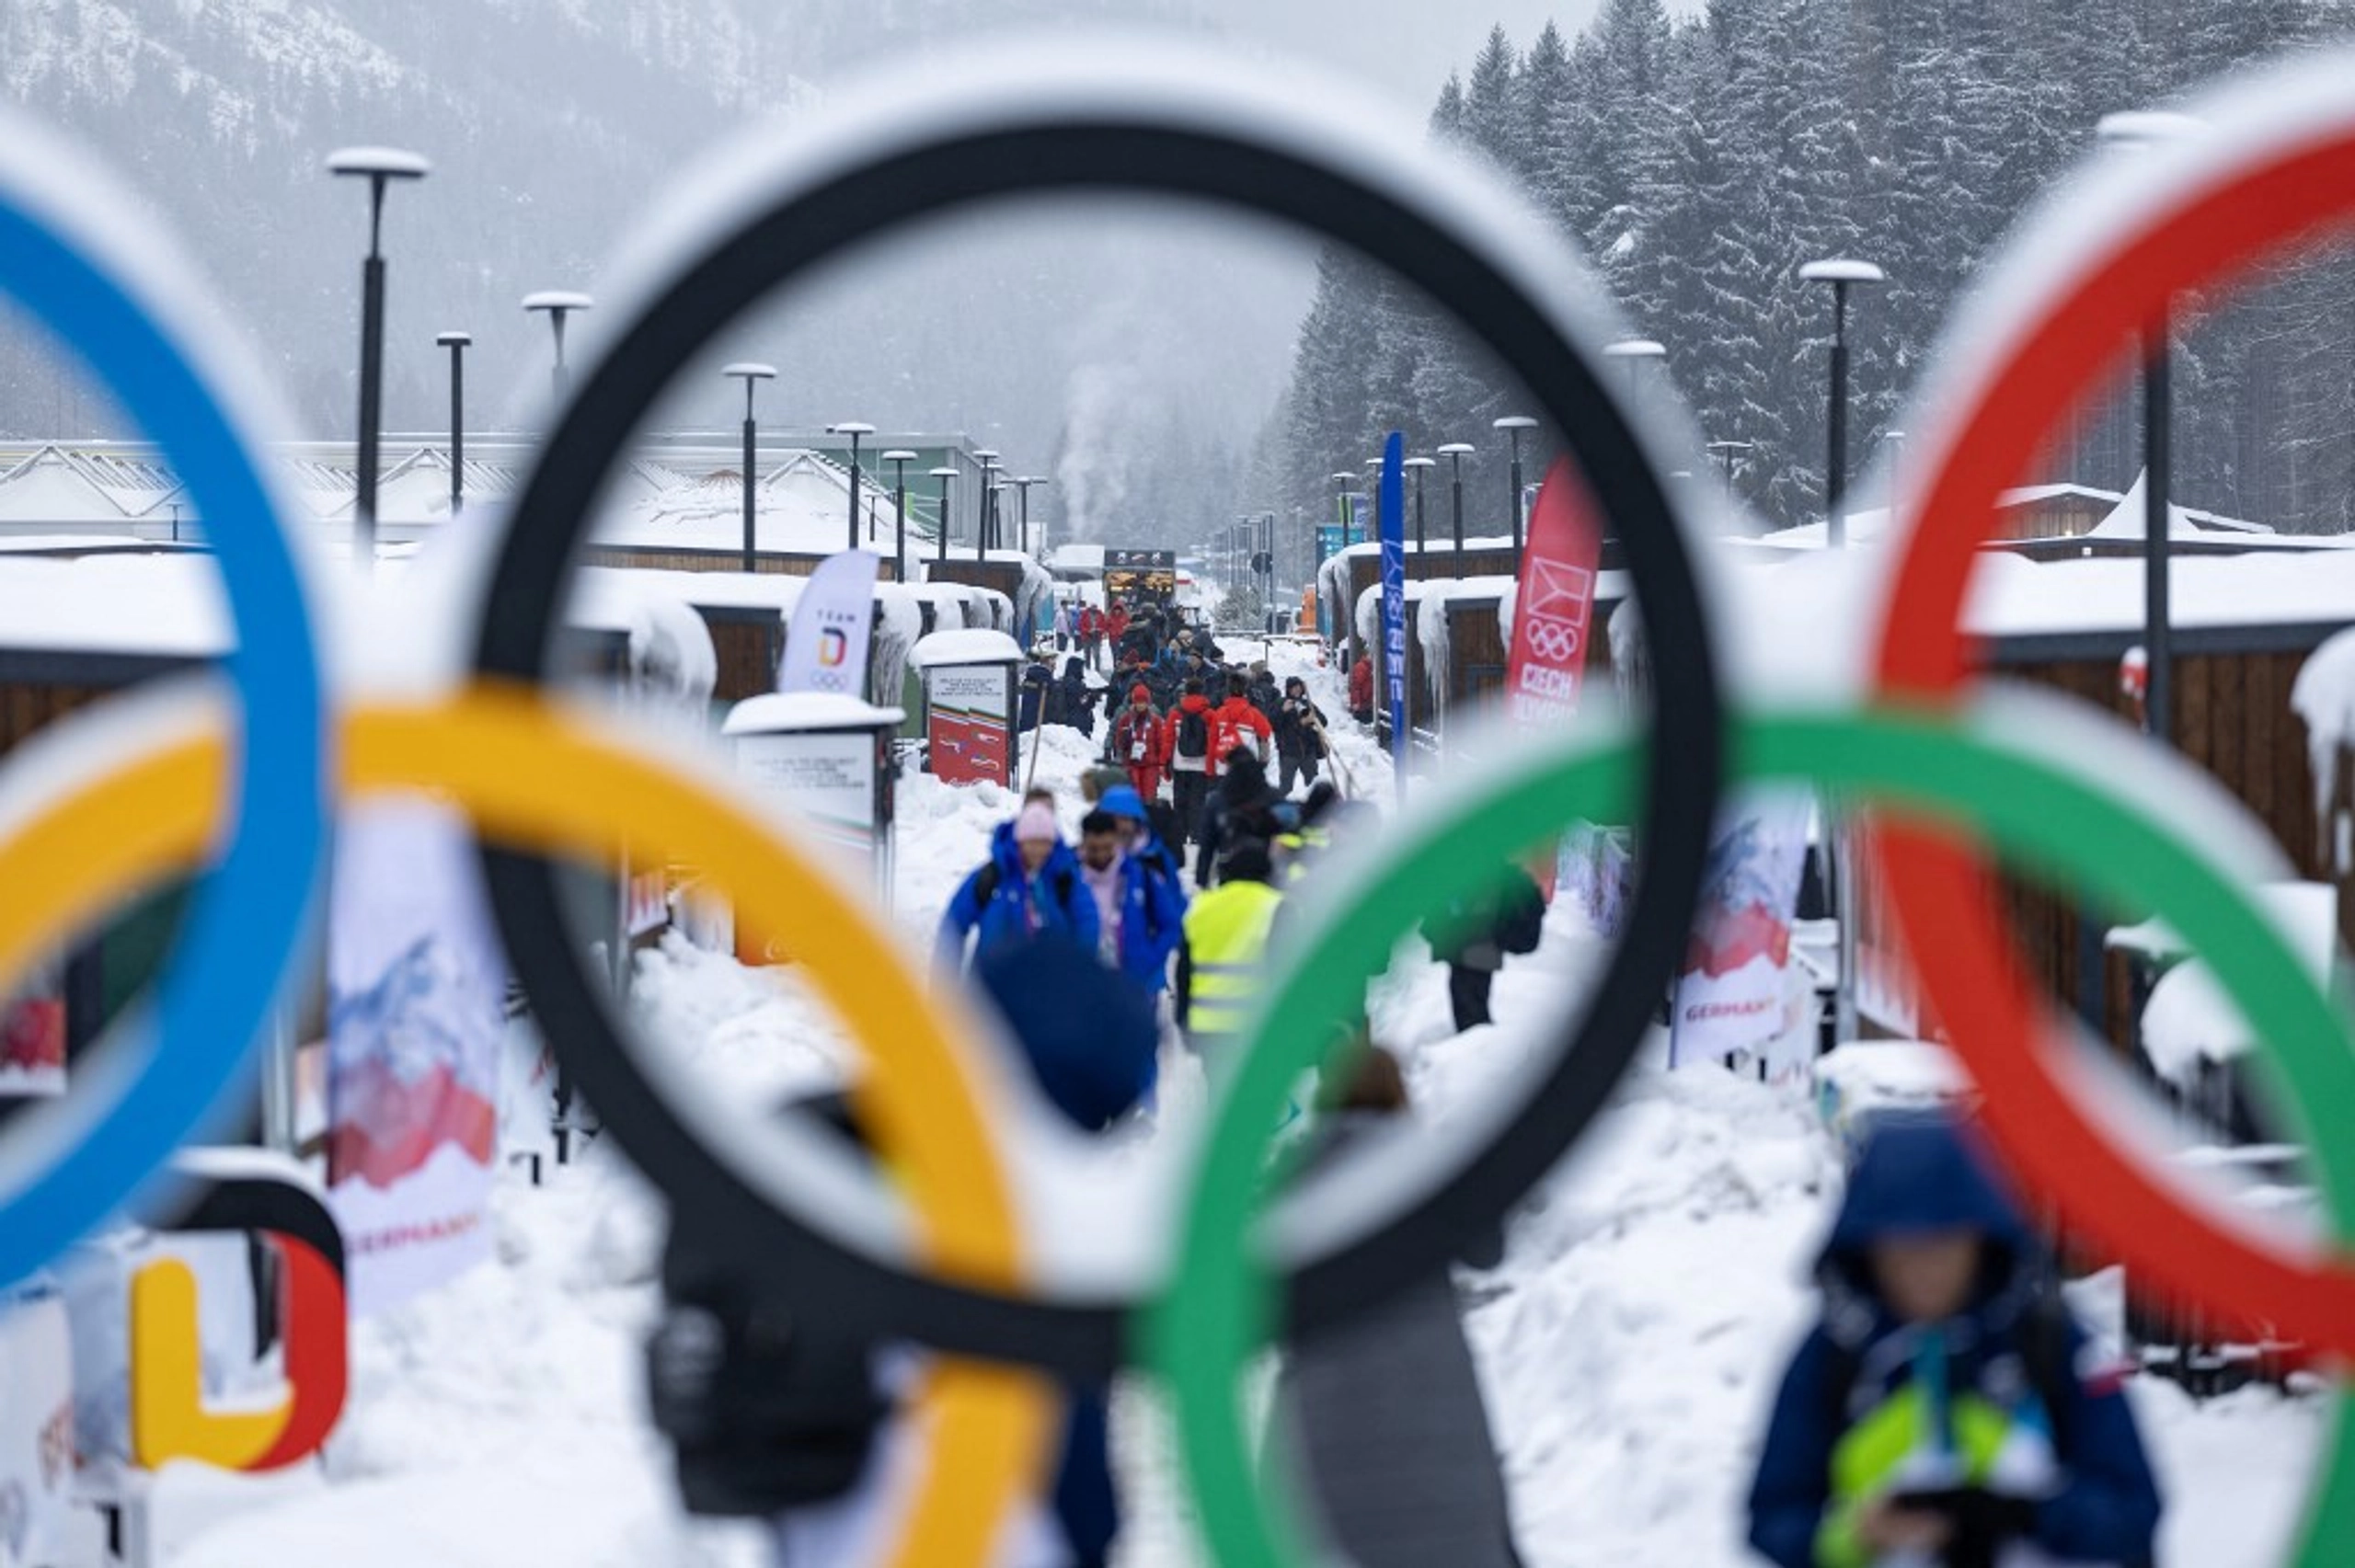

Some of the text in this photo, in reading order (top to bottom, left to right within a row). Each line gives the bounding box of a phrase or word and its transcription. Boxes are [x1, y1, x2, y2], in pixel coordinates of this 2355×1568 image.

[817, 609, 856, 623] TEAM
[1521, 663, 1572, 700] CZECH
[1685, 993, 1776, 1022] GERMANY
